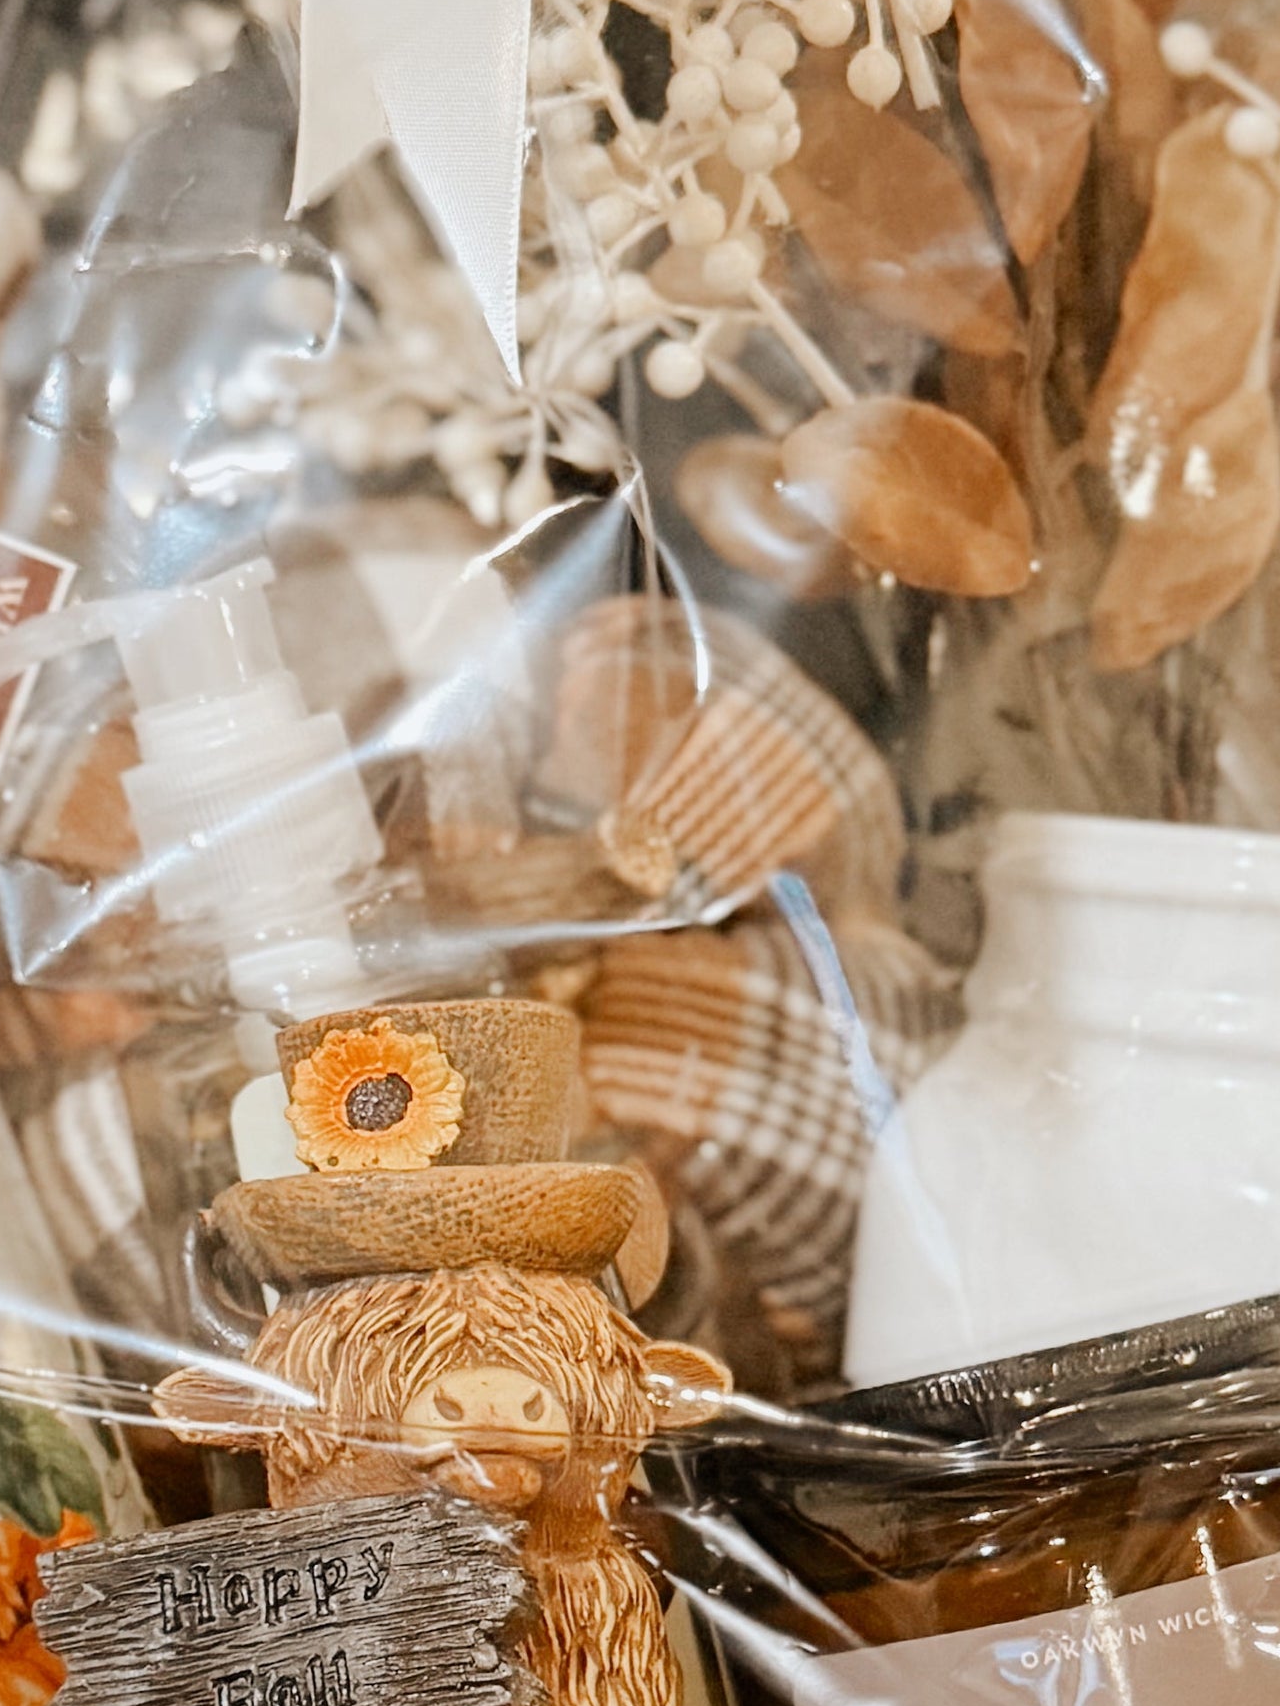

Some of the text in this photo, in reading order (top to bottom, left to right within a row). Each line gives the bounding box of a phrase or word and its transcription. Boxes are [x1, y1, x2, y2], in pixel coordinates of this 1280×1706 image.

[153, 1540, 396, 1636] Happy
[1019, 1605, 1231, 1671] OAKWYN WICK
